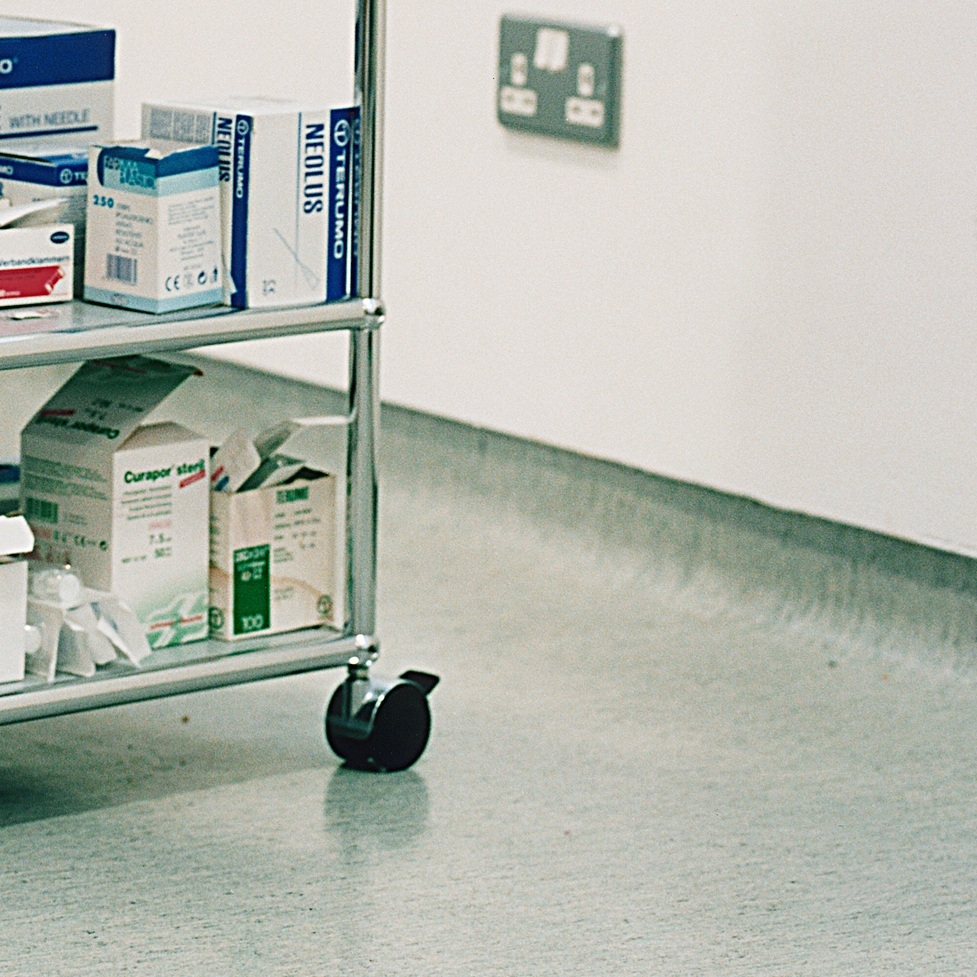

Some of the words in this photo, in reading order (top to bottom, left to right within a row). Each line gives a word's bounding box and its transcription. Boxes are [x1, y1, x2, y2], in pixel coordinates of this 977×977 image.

[236, 138, 245, 198] TERUMO
[303, 123, 324, 214] NEOLUS
[93, 195, 115, 209] 250
[334, 149, 346, 259] TERUMO
[124, 467, 171, 483] Curapor
